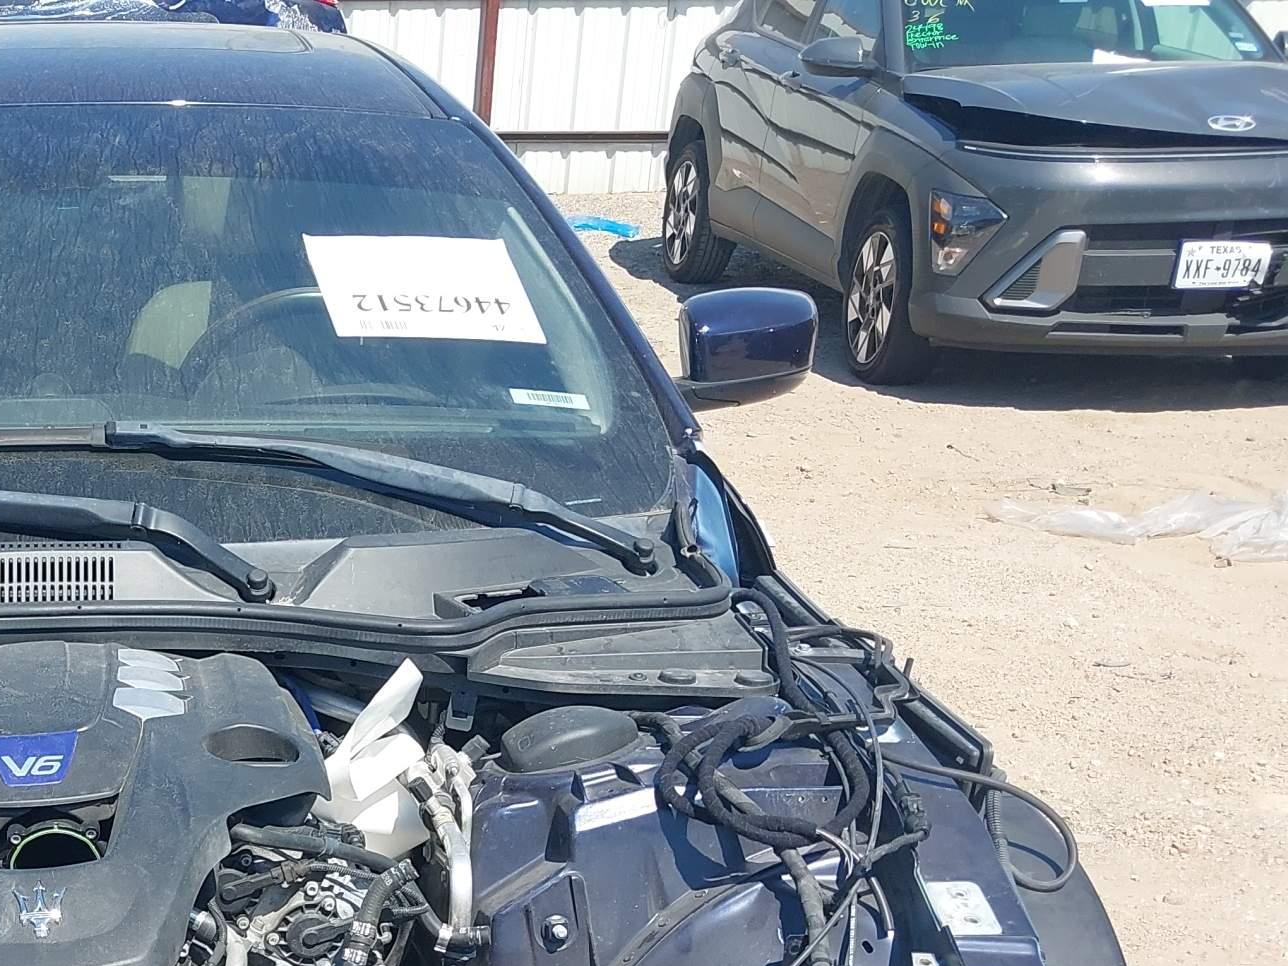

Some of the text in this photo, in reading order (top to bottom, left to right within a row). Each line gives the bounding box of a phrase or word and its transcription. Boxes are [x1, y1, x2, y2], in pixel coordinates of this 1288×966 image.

[1210, 245, 1242, 254] TEXAS
[351, 293, 512, 315] 44673512
[0, 754, 64, 777] V6
